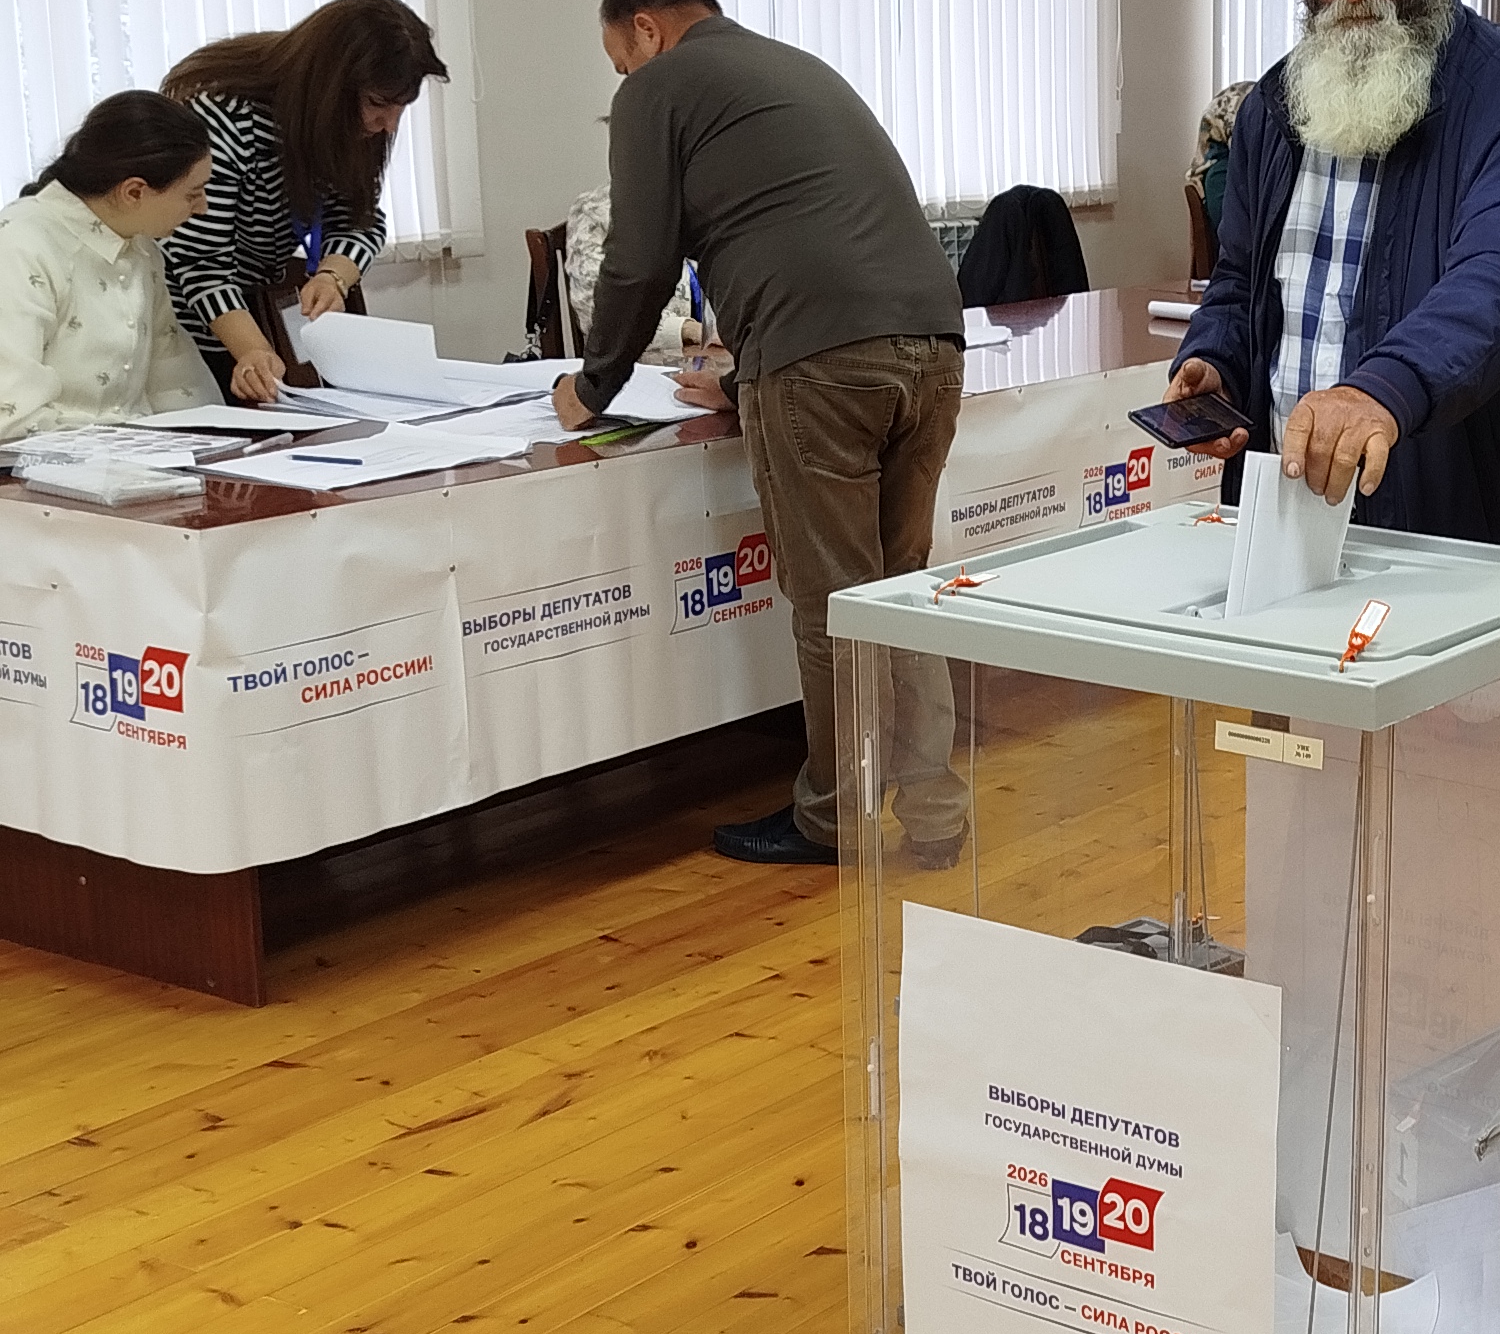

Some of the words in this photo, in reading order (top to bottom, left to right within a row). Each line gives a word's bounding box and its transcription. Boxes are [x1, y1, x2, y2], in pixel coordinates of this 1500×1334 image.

[1083, 465, 1104, 479] 2026
[1167, 452, 1191, 470] ТВОЙ
[1194, 464, 1217, 481] СИЛА
[951, 499, 998, 523] ВЫБОРЫ
[999, 485, 1056, 513] ДЕПУТАТОВ
[1085, 491, 1103, 516] 18
[1106, 472, 1125, 499] 19
[1128, 456, 1149, 483] 20
[964, 506, 1041, 538] ГОСУДАРСТВЕННОЙ
[1041, 501, 1066, 518] ДУМЫ
[1108, 501, 1152, 521] СЕНТЯБРЯ
[674, 556, 702, 575] 2026
[679, 588, 705, 619] 18
[708, 565, 734, 597] 19
[738, 543, 769, 576] 20
[462, 606, 536, 637] ВЫБОРЫ
[540, 584, 632, 621] ДЕПУТАТОВ
[484, 611, 611, 654] ГОСУДАРСТВЕННОЙ
[614, 604, 651, 625] ДУМЫ
[713, 596, 773, 623] СЕНТЯБРЯ
[75, 642, 105, 662] 2026
[227, 662, 288, 693] ТВОЙ
[293, 650, 355, 680] ГОЛОС
[13, 669, 47, 689] ДУМЫ
[80, 680, 108, 716] 18
[111, 669, 138, 705] 19
[142, 660, 181, 698] 20
[301, 677, 353, 703] СИЛА
[357, 655, 434, 689] РОССИИ!
[117, 720, 187, 750] СЕНТЯБРЯ
[989, 1084, 1066, 1119] ВЫБОРЫ
[1071, 1107, 1180, 1148] ДЕПУТАТОВ
[985, 1113, 1132, 1164] ГОСУДАРСТВЕННОЙ
[1136, 1154, 1183, 1178] ДУМЫ
[1007, 1164, 1048, 1187] 2026
[1013, 1203, 1050, 1242] 18
[1057, 1196, 1095, 1237] 19
[1102, 1192, 1150, 1235] 20
[1060, 1249, 1155, 1289] СЕНТЯБРЯ
[951, 1263, 996, 1291] ТВОЙ
[1002, 1280, 1060, 1310] ГОЛОС
[1081, 1304, 1130, 1333] СИЛА
